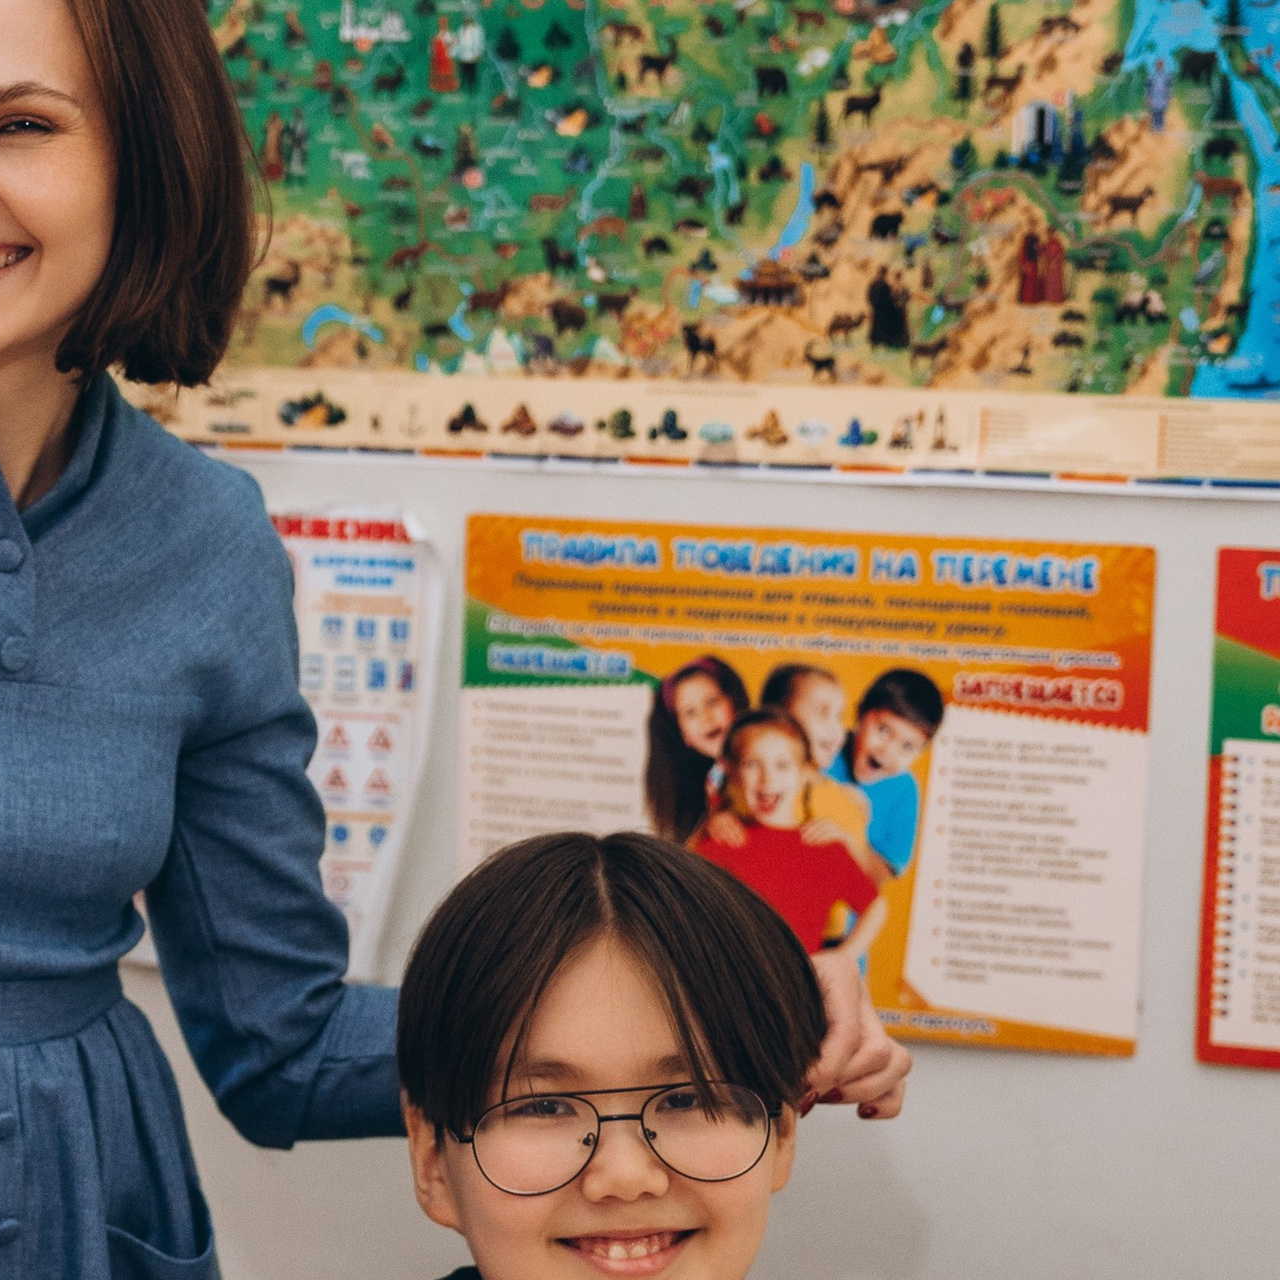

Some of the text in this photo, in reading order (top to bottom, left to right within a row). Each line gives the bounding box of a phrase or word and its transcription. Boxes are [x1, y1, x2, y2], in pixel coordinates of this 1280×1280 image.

[522, 530, 1100, 593] ПРАВИЛА ПОВЕДЕНИЯ НА ПЕРЕМЕНЕ
